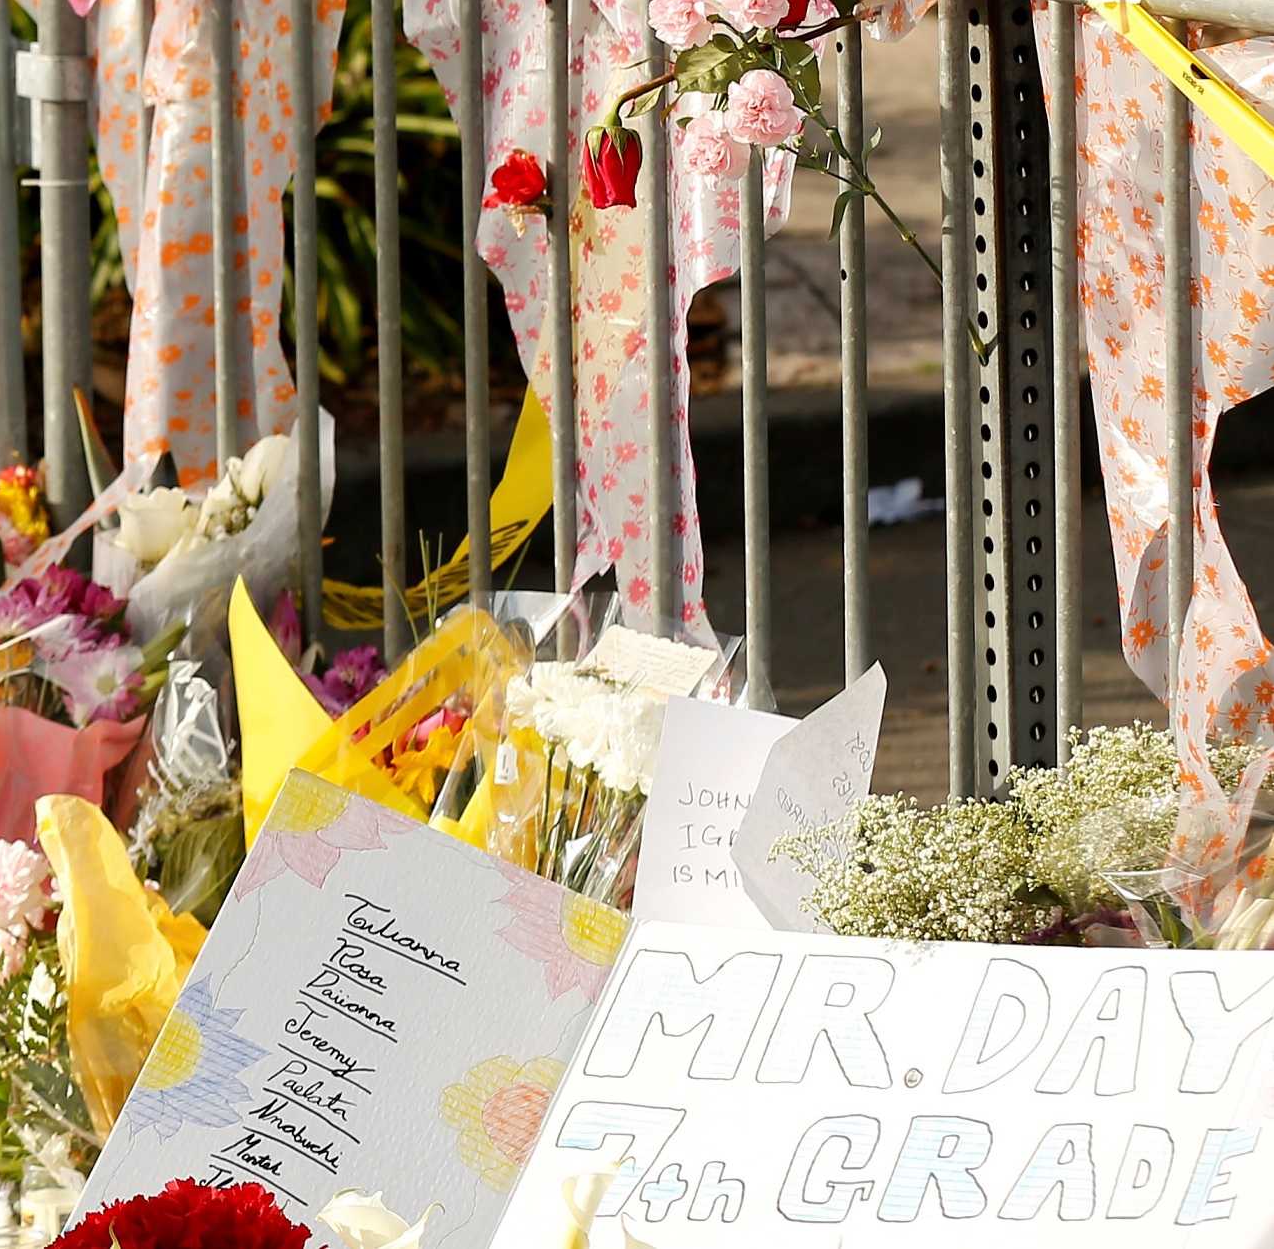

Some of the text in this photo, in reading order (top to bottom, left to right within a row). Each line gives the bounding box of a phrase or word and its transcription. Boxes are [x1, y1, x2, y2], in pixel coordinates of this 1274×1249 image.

[329, 937, 388, 990] Rosa
[284, 1000, 376, 1078] Jeremy
[776, 1113, 1263, 1226] GRADE
